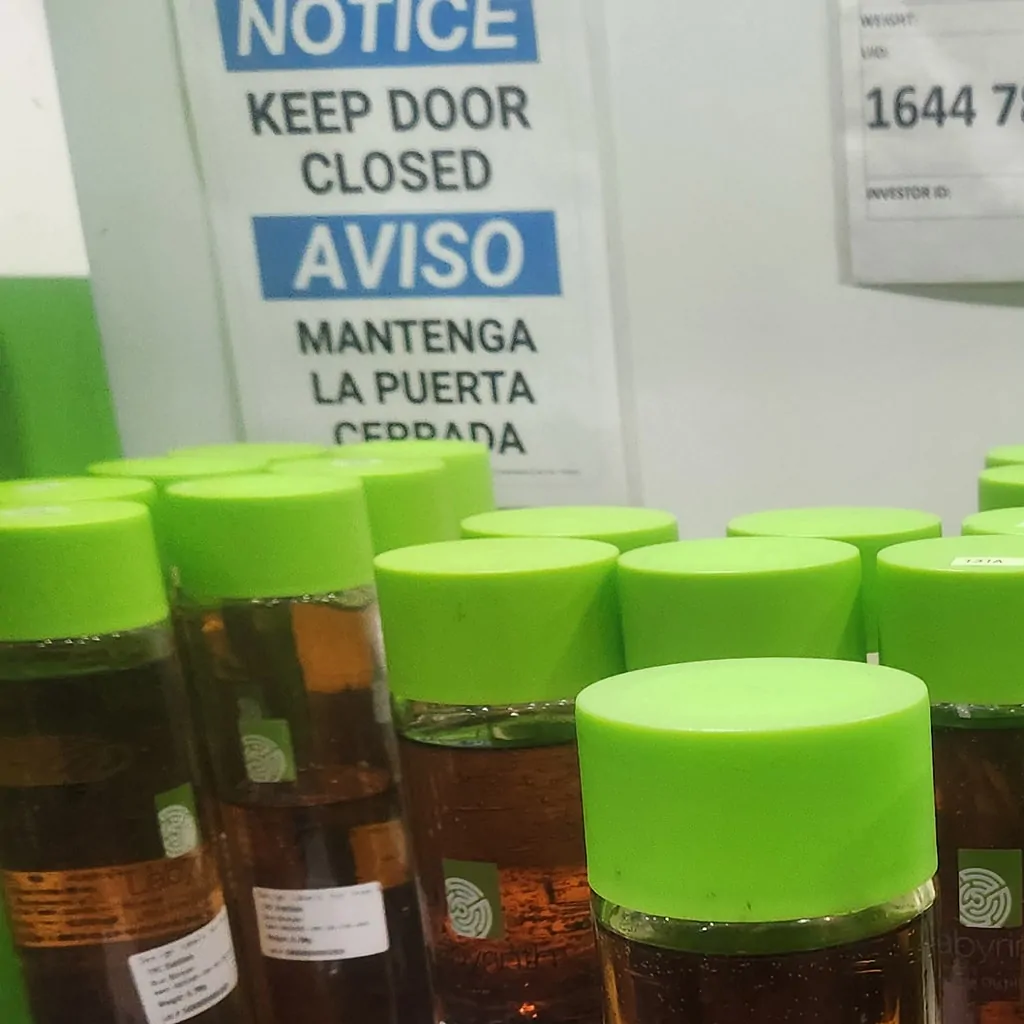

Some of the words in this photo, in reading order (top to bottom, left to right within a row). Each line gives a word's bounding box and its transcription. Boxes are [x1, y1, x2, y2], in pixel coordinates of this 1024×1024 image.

[237, 0, 518, 57] NOTICE
[247, 89, 373, 135] KEEP
[388, 85, 532, 131] DOOR
[866, 84, 977, 130] 1644
[302, 149, 493, 195] CLOSED
[293, 220, 525, 292] AVISO
[296, 318, 538, 355] MANTENGA
[310, 371, 366, 405] LA
[377, 369, 536, 405] PUERTA
